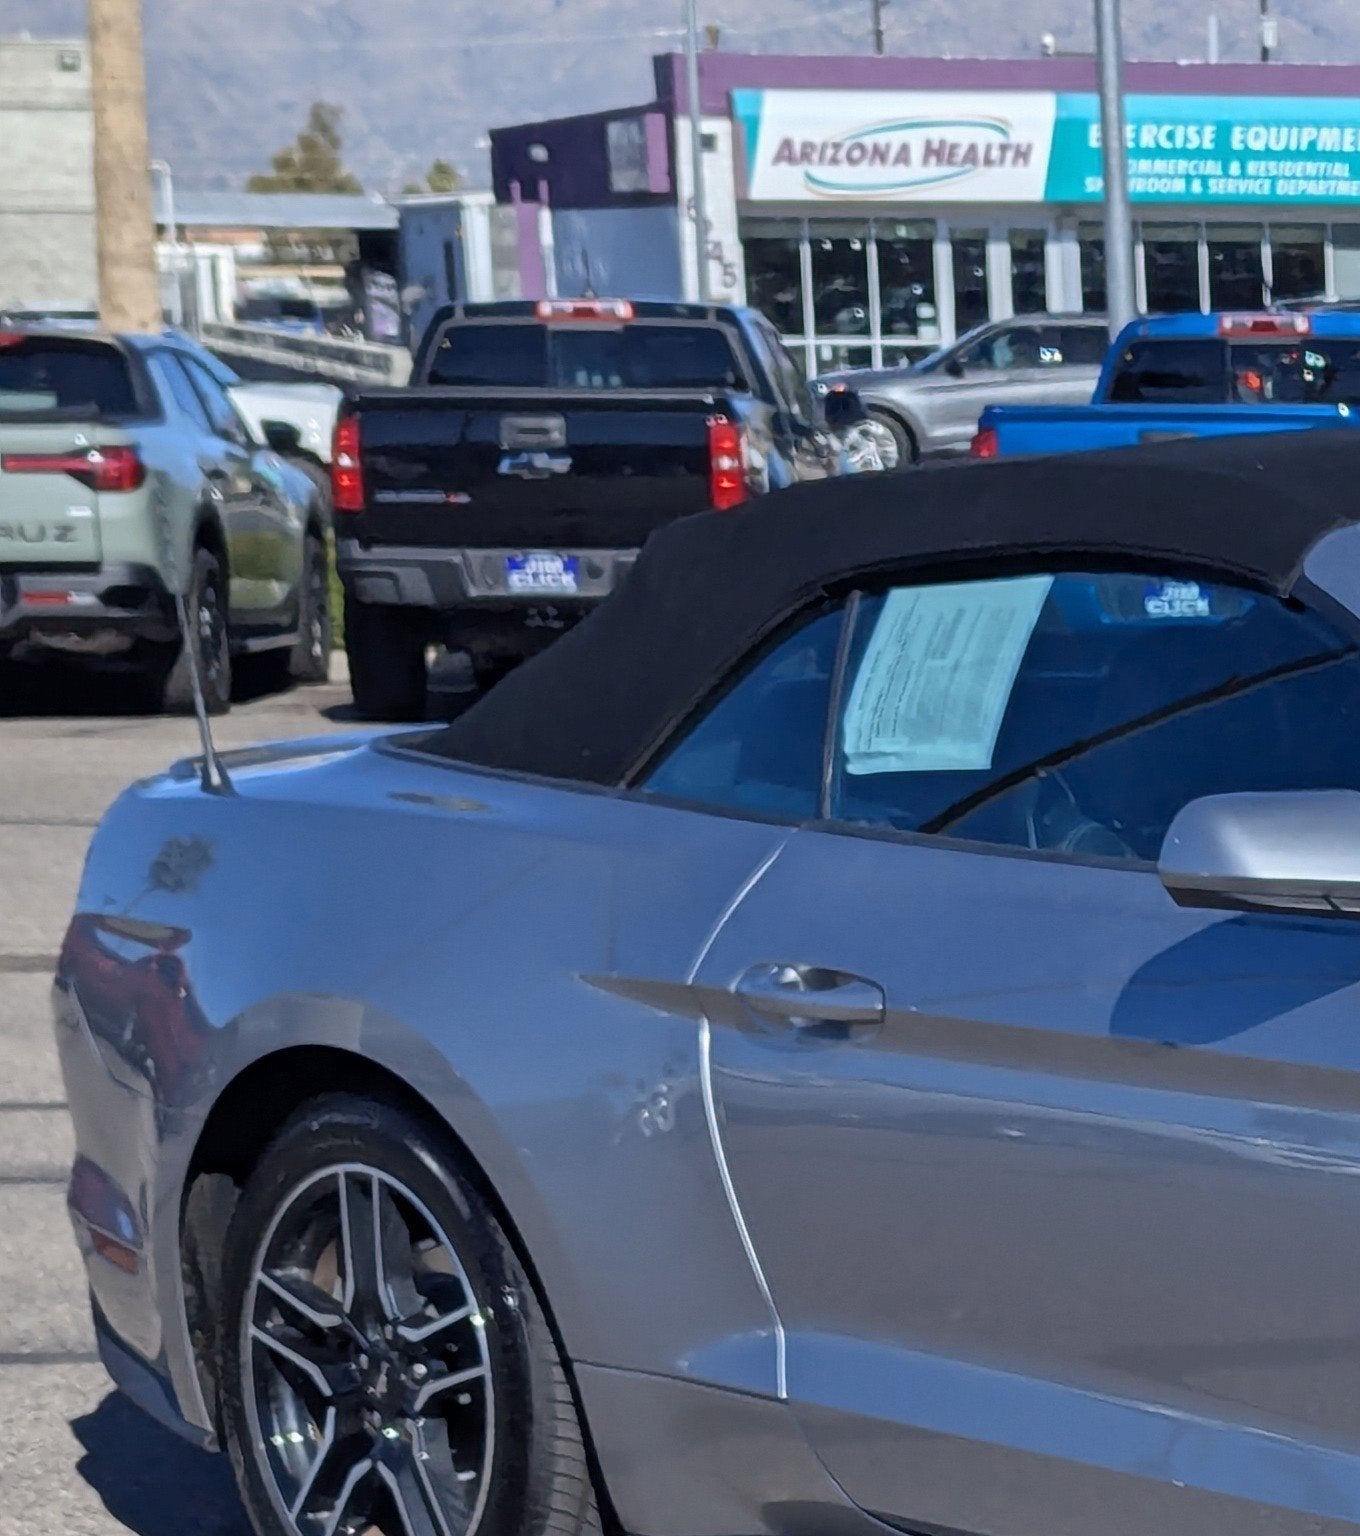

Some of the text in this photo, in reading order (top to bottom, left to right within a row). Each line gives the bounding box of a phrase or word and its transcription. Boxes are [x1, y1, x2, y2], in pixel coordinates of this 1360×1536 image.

[1087, 123, 1217, 150] EERCISE
[771, 137, 1033, 168] ARIZONA HEALTH
[1247, 160, 1350, 178] RESIDENTIAL
[1208, 177, 1272, 195] SERVICE
